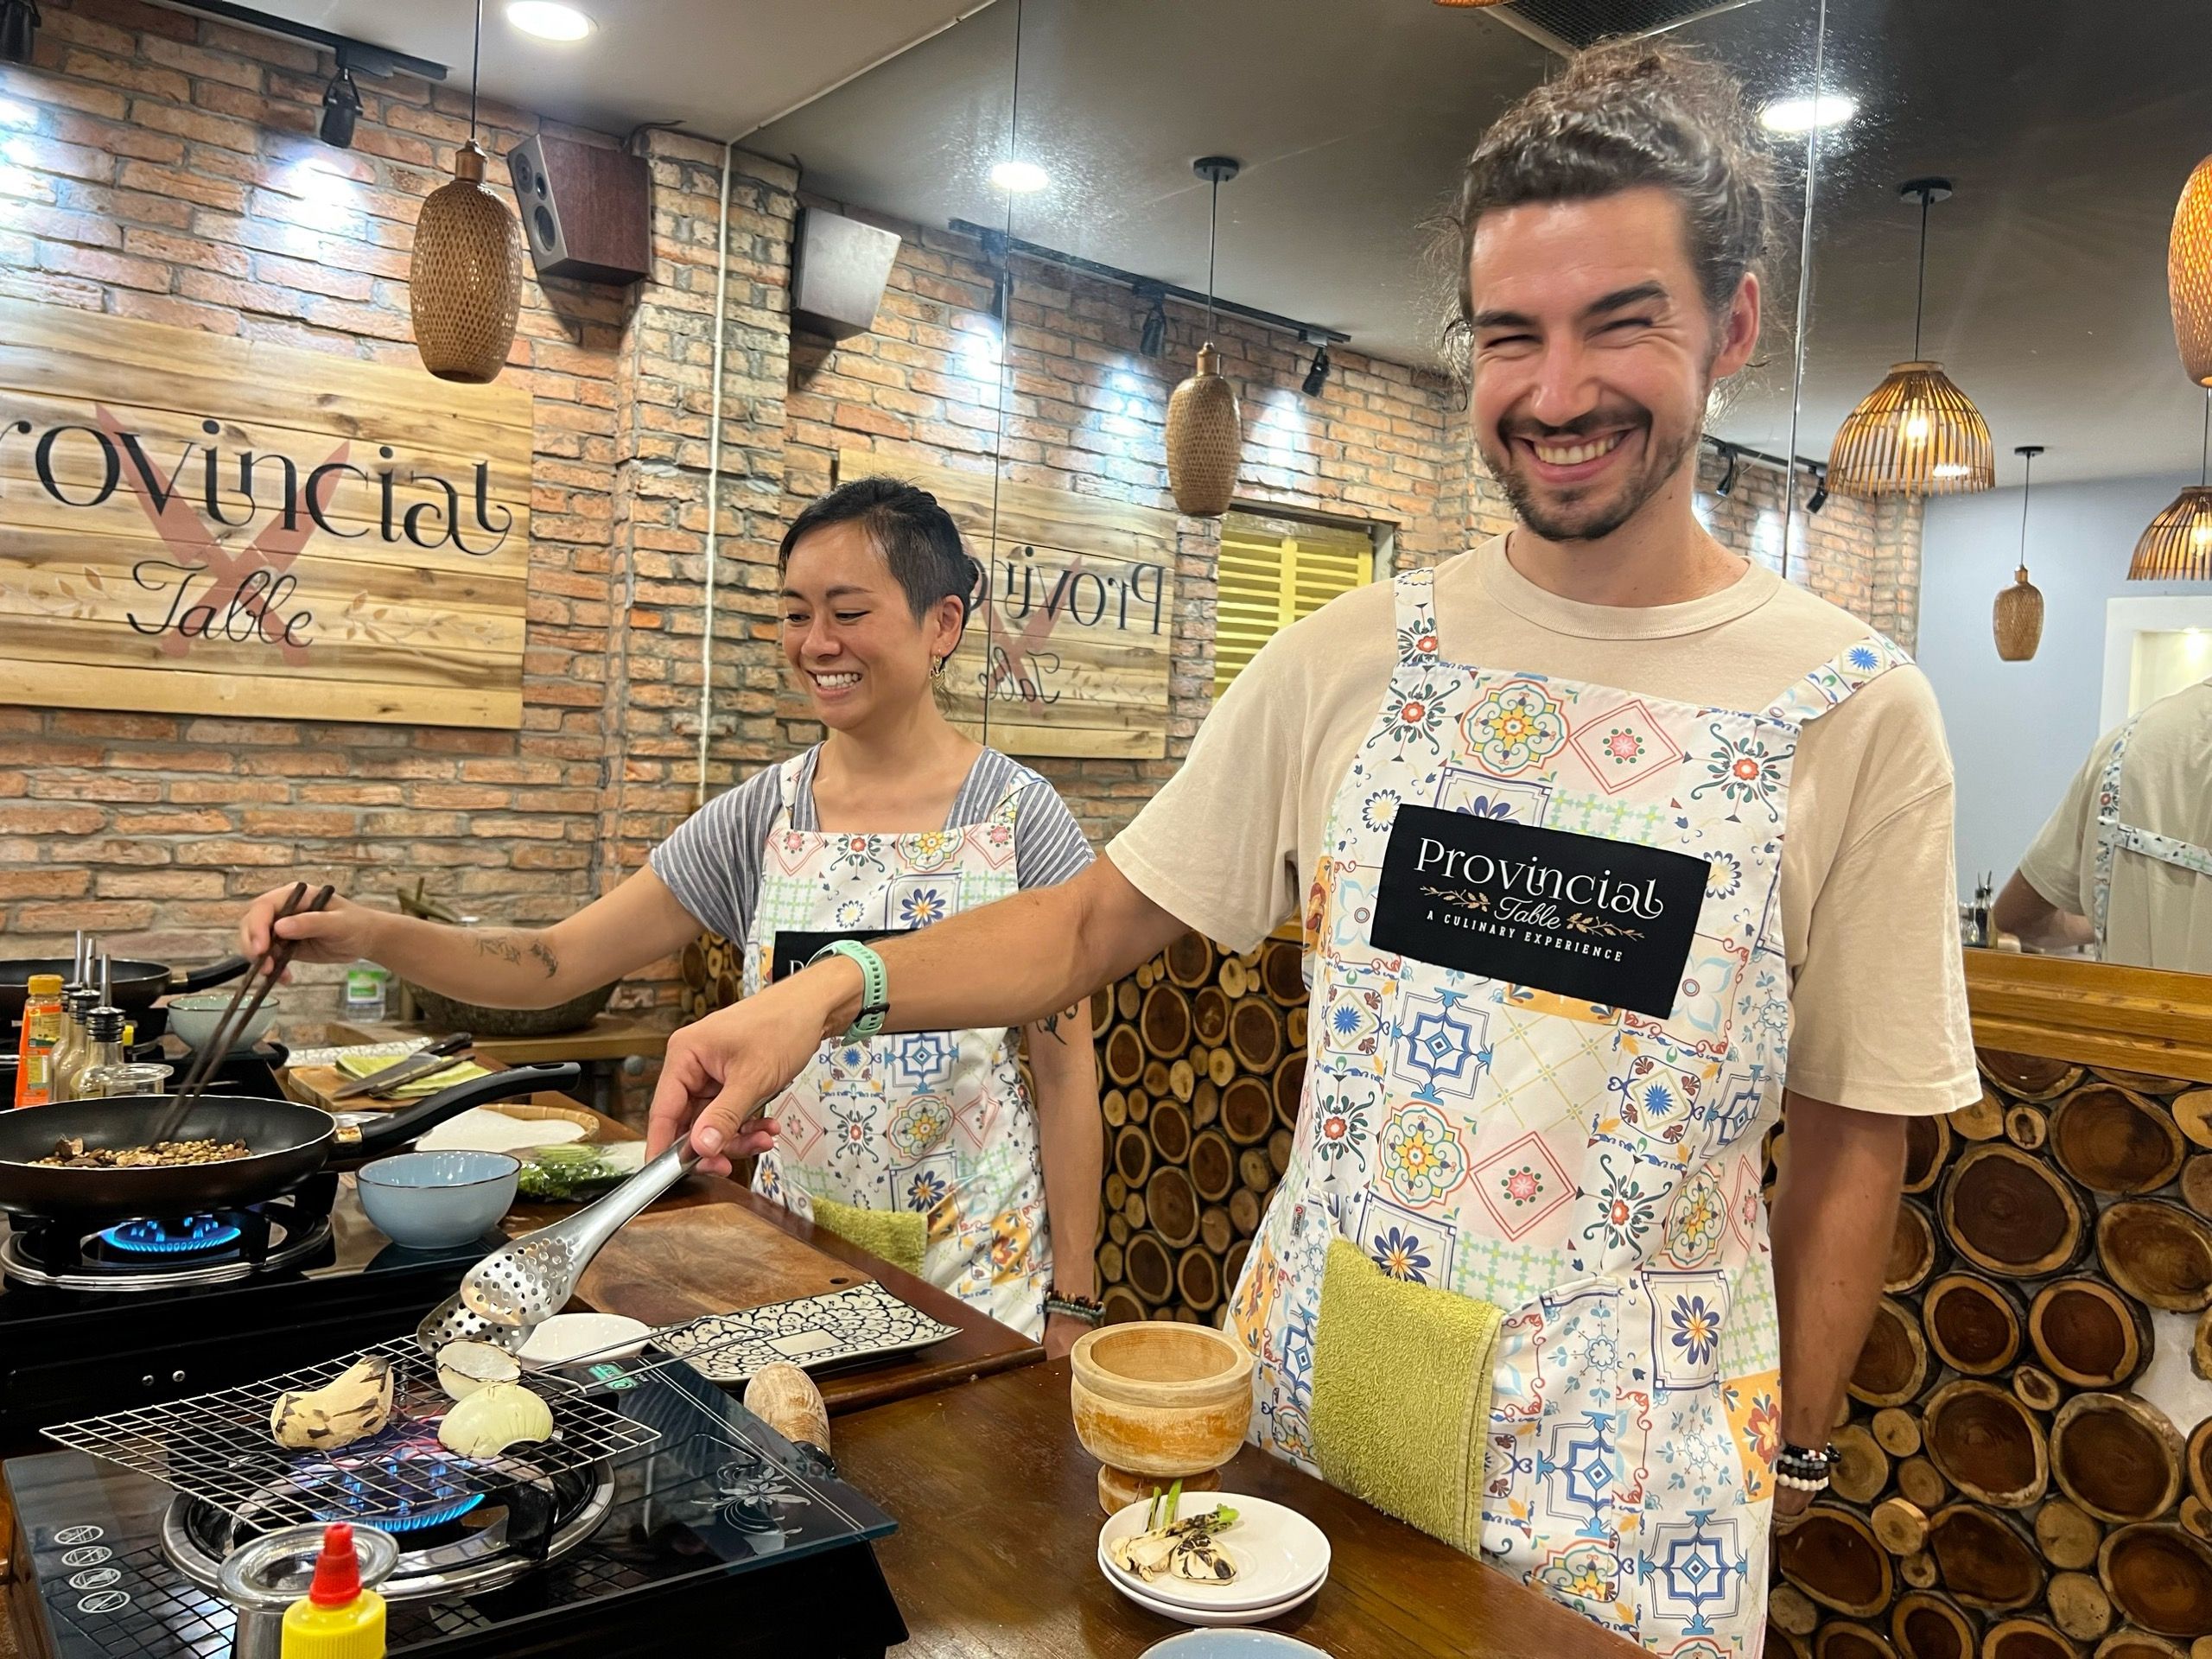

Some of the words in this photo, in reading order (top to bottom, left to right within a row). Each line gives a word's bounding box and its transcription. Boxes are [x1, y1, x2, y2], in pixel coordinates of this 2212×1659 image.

[126, 560, 314, 648] Table
[1414, 836, 1664, 920] Provincial
[1426, 910, 1434, 921] A
[1443, 913, 1516, 939] CULINARY
[1523, 931, 1624, 963] EXPERIENCE
[1493, 896, 1562, 931] Table
